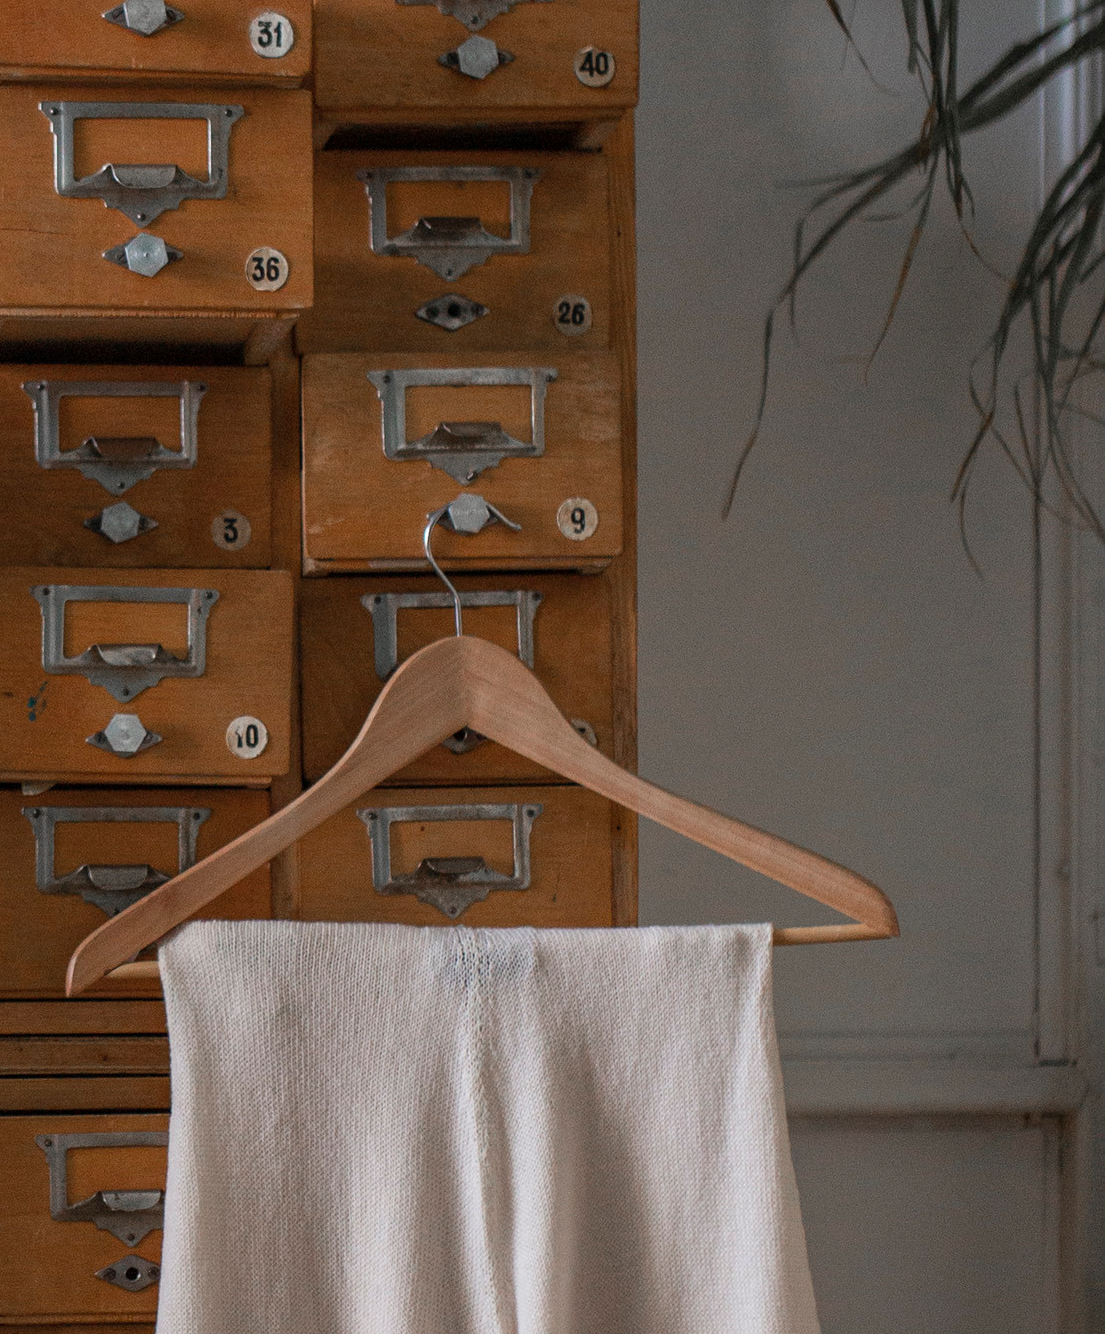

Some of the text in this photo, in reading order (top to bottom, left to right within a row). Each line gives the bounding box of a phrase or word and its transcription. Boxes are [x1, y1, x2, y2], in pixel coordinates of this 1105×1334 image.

[257, 21, 282, 48] 31
[579, 51, 609, 77] 40
[251, 257, 279, 281] 36
[558, 301, 585, 325] 26
[223, 518, 239, 543] 3
[570, 507, 586, 534] 9
[234, 724, 259, 748] 10
